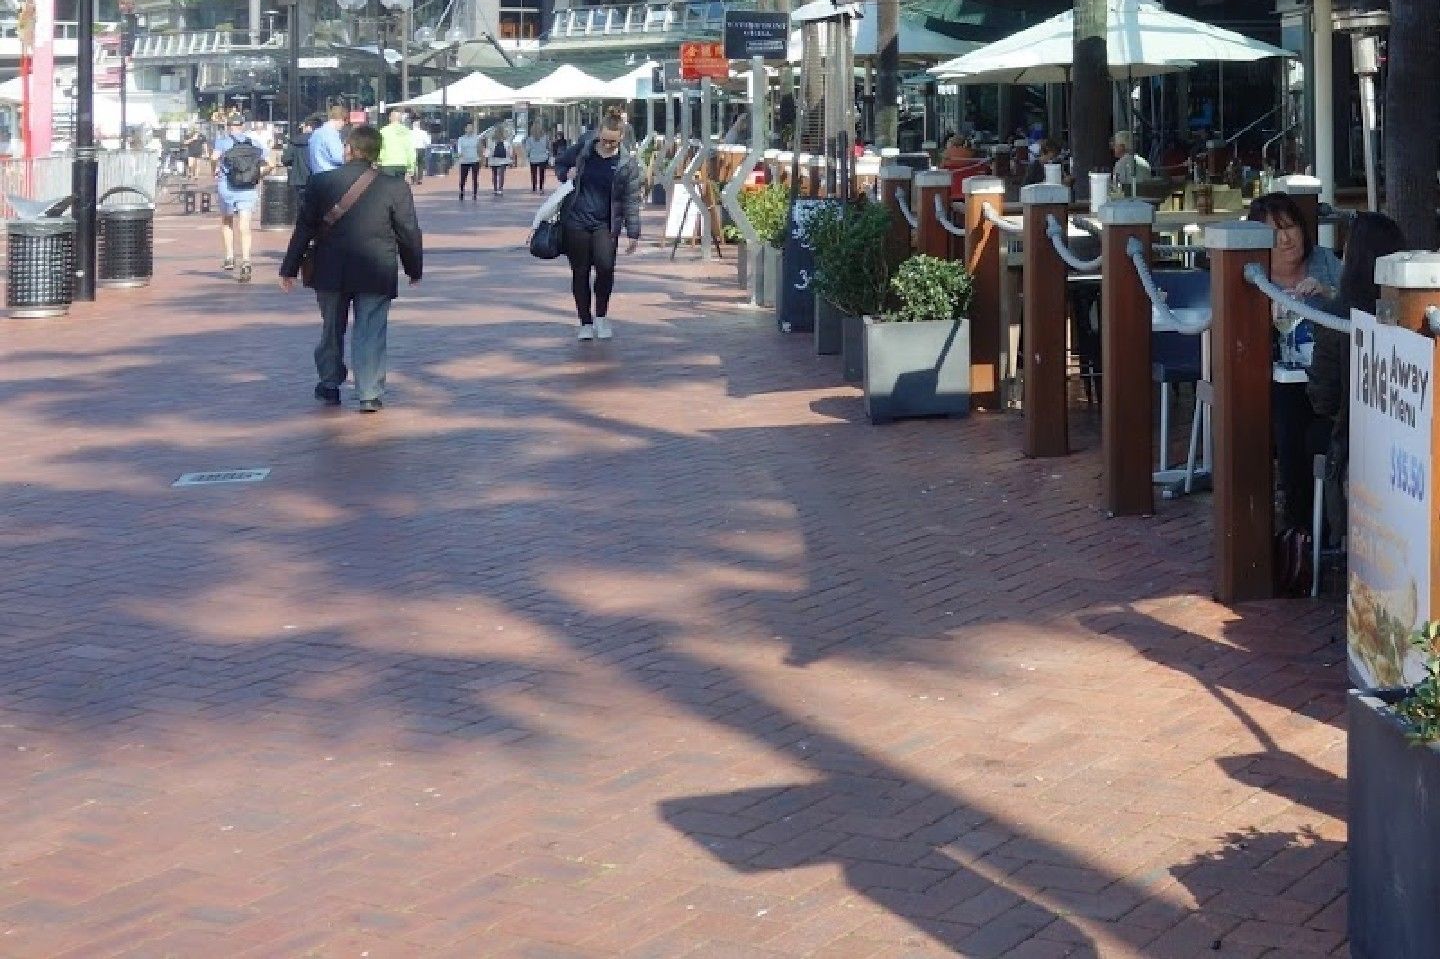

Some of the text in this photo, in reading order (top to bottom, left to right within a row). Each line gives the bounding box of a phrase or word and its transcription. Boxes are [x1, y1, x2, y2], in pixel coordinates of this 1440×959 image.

[1355, 327, 1429, 415] Take Away
[1389, 386, 1416, 429] Menu
